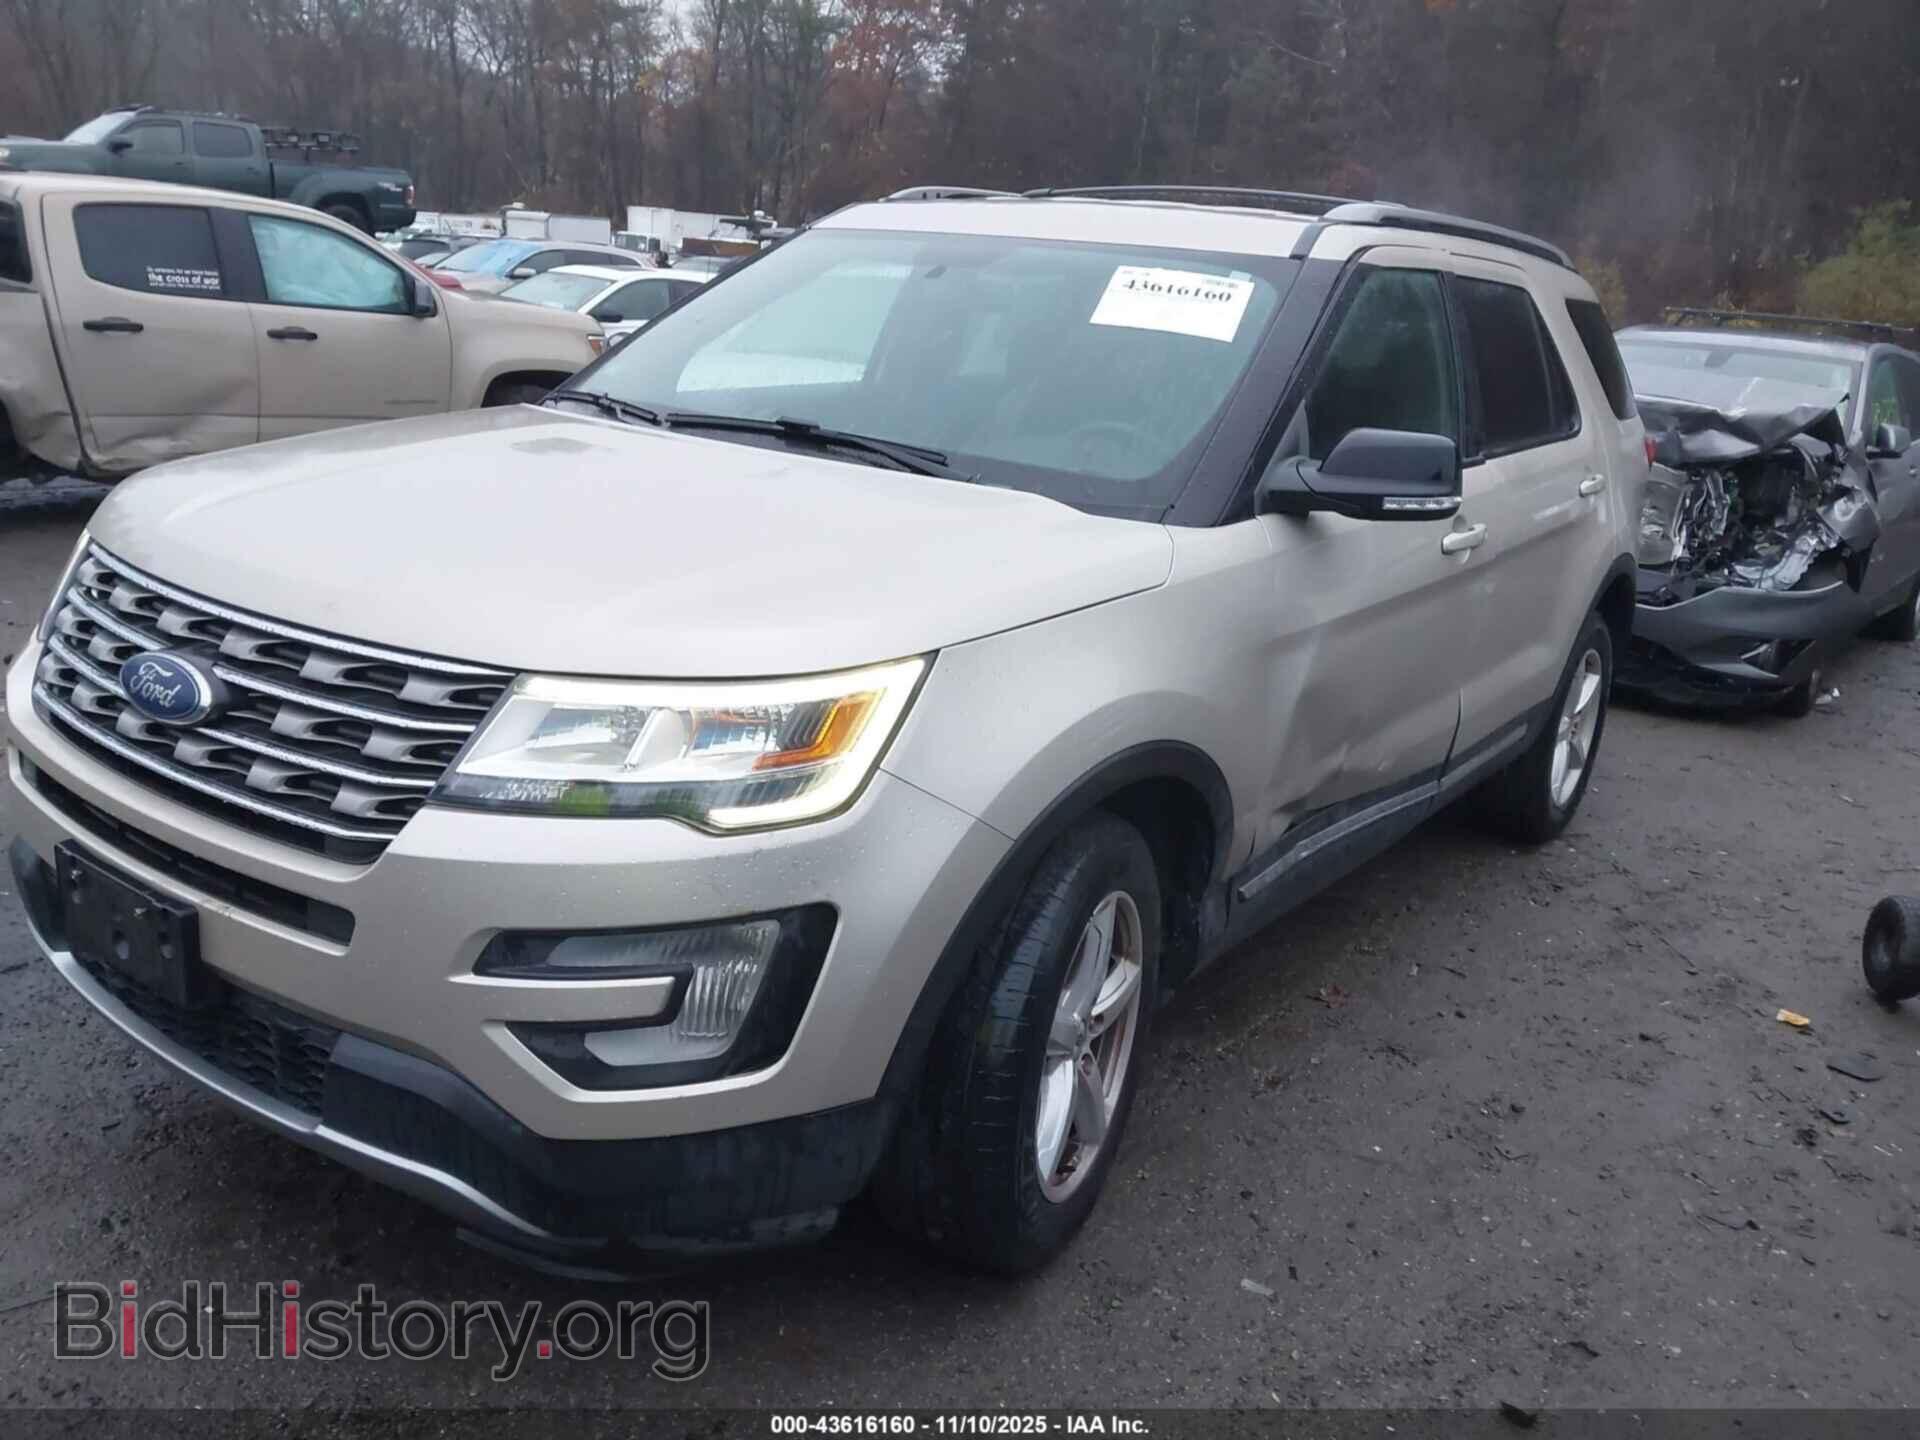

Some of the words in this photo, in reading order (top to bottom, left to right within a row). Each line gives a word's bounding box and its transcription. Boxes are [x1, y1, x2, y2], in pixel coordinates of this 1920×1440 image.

[147, 272, 163, 282] the
[166, 275, 190, 284] cross
[191, 275, 201, 284] of
[130, 661, 182, 708] Ford
